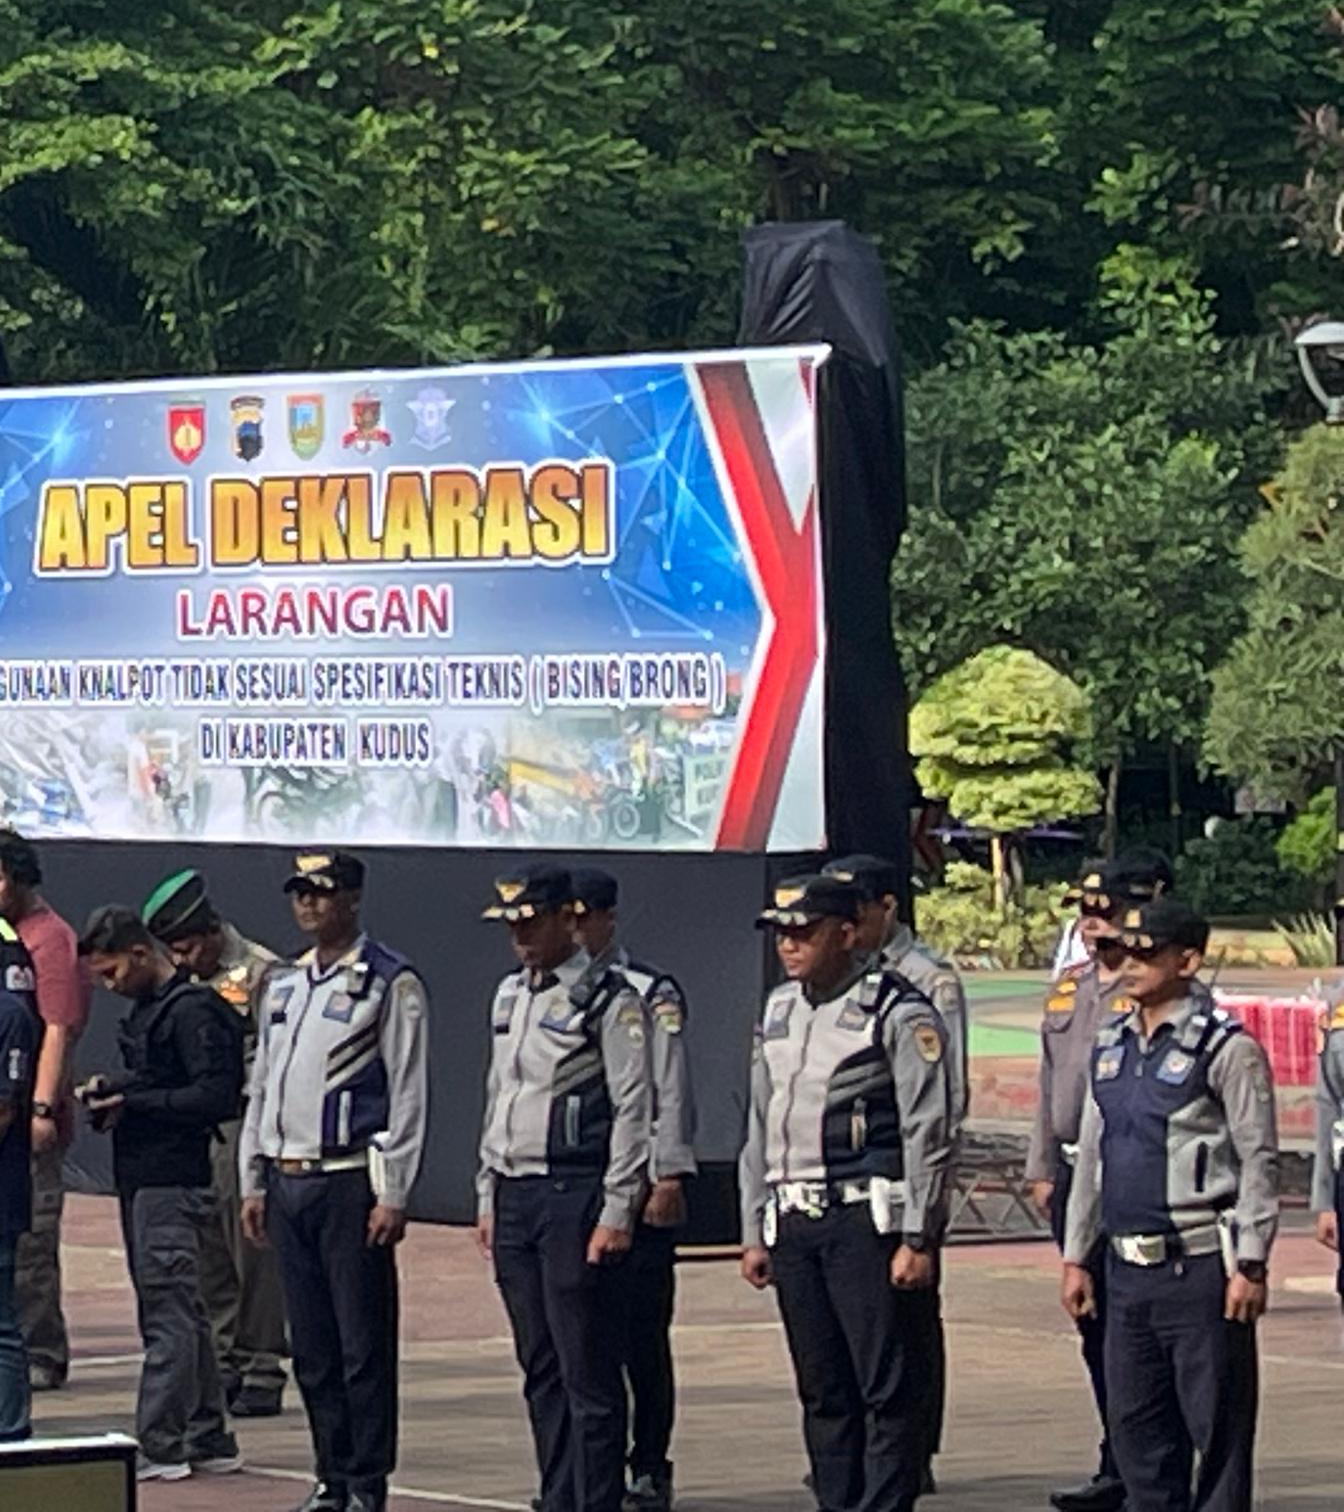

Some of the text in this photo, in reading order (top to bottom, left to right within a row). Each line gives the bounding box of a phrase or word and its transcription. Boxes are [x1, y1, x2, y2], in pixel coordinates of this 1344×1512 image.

[38, 463, 611, 573] APEL DEKLARASI
[179, 588, 450, 636] LARANGAN
[79, 665, 165, 702] KNALPOT
[171, 664, 230, 702] TIDAK
[236, 663, 308, 701] SESUAI
[313, 661, 442, 701] SPESIFIKASI
[447, 660, 523, 700] TEKNIS
[200, 722, 430, 762] DI KABUPATEN KUDUS
